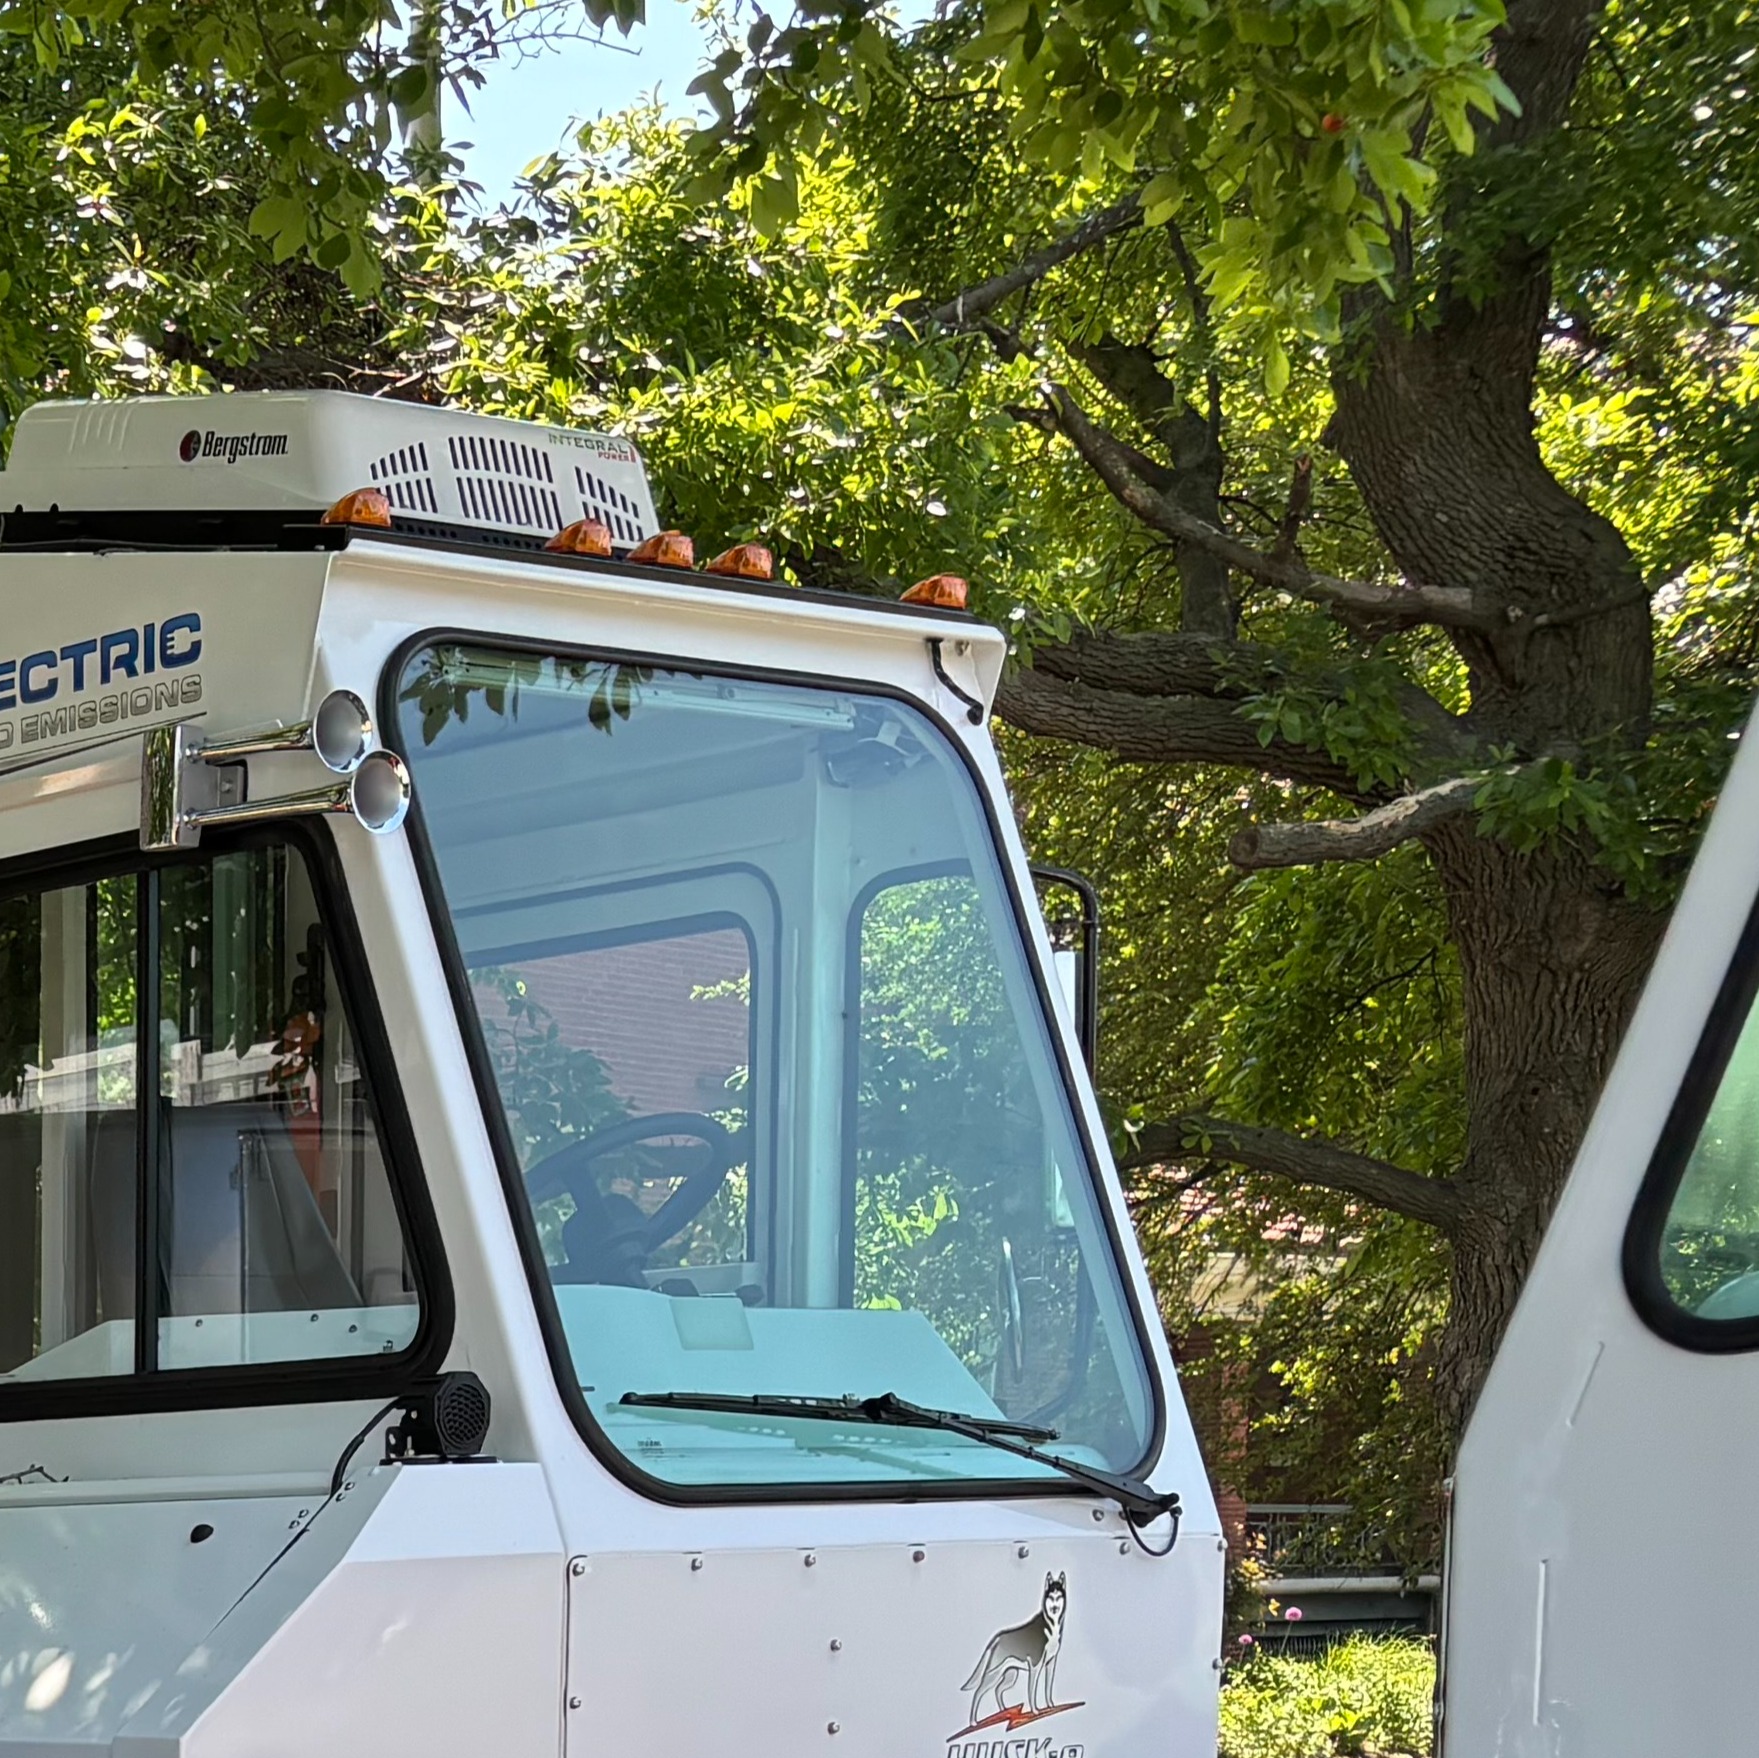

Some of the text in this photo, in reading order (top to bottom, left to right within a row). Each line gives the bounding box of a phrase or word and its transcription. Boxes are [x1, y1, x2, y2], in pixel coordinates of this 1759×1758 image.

[202, 430, 288, 464] Bergstrom
[548, 433, 628, 454] INTEGRAL
[20, 673, 204, 744] EMISSIONS
